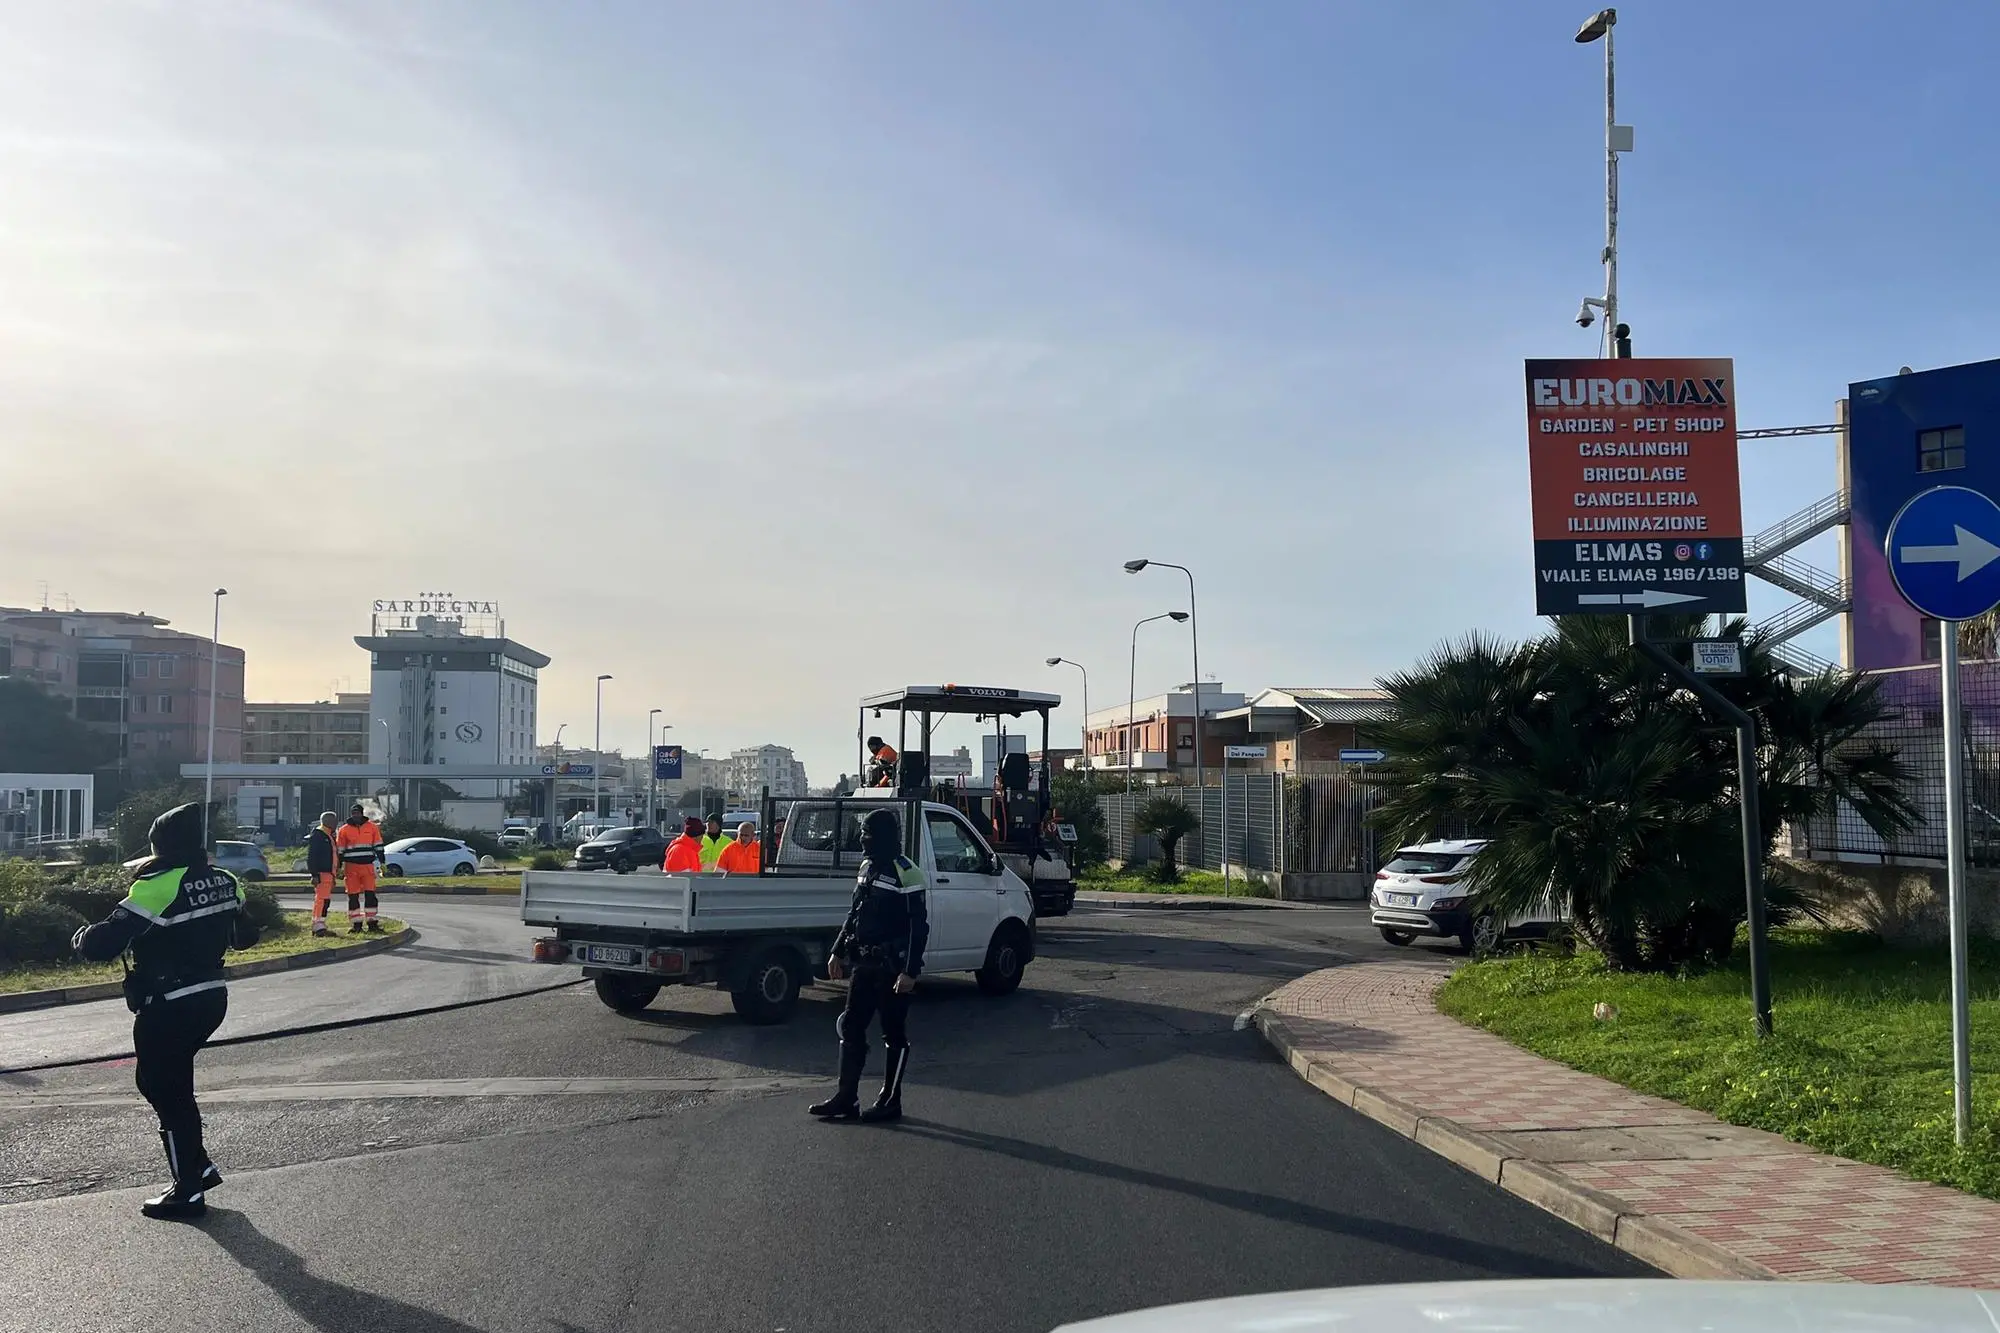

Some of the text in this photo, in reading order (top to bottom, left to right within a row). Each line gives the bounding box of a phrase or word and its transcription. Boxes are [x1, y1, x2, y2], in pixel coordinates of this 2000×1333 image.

[1534, 378, 1727, 407] EUROMAX
[1539, 418, 1615, 434] GARDEN
[1633, 418, 1669, 433] PET
[1674, 417, 1725, 432] SHOP
[1579, 442, 1689, 457] CASALINGHI
[1583, 467, 1687, 483] BRICOLAGE
[1574, 491, 1699, 508] CANCELLERIA
[1568, 516, 1708, 533] ILLUMINAZIONE
[1575, 543, 1663, 562] ELMAS
[1541, 567, 1740, 583] VIALE ELMAS 196/198
[375, 600, 492, 613] SARDEGNA
[969, 688, 1006, 696] VOLVO
[184, 876, 231, 892] POLIZIA
[189, 887, 234, 906] LOCALE
